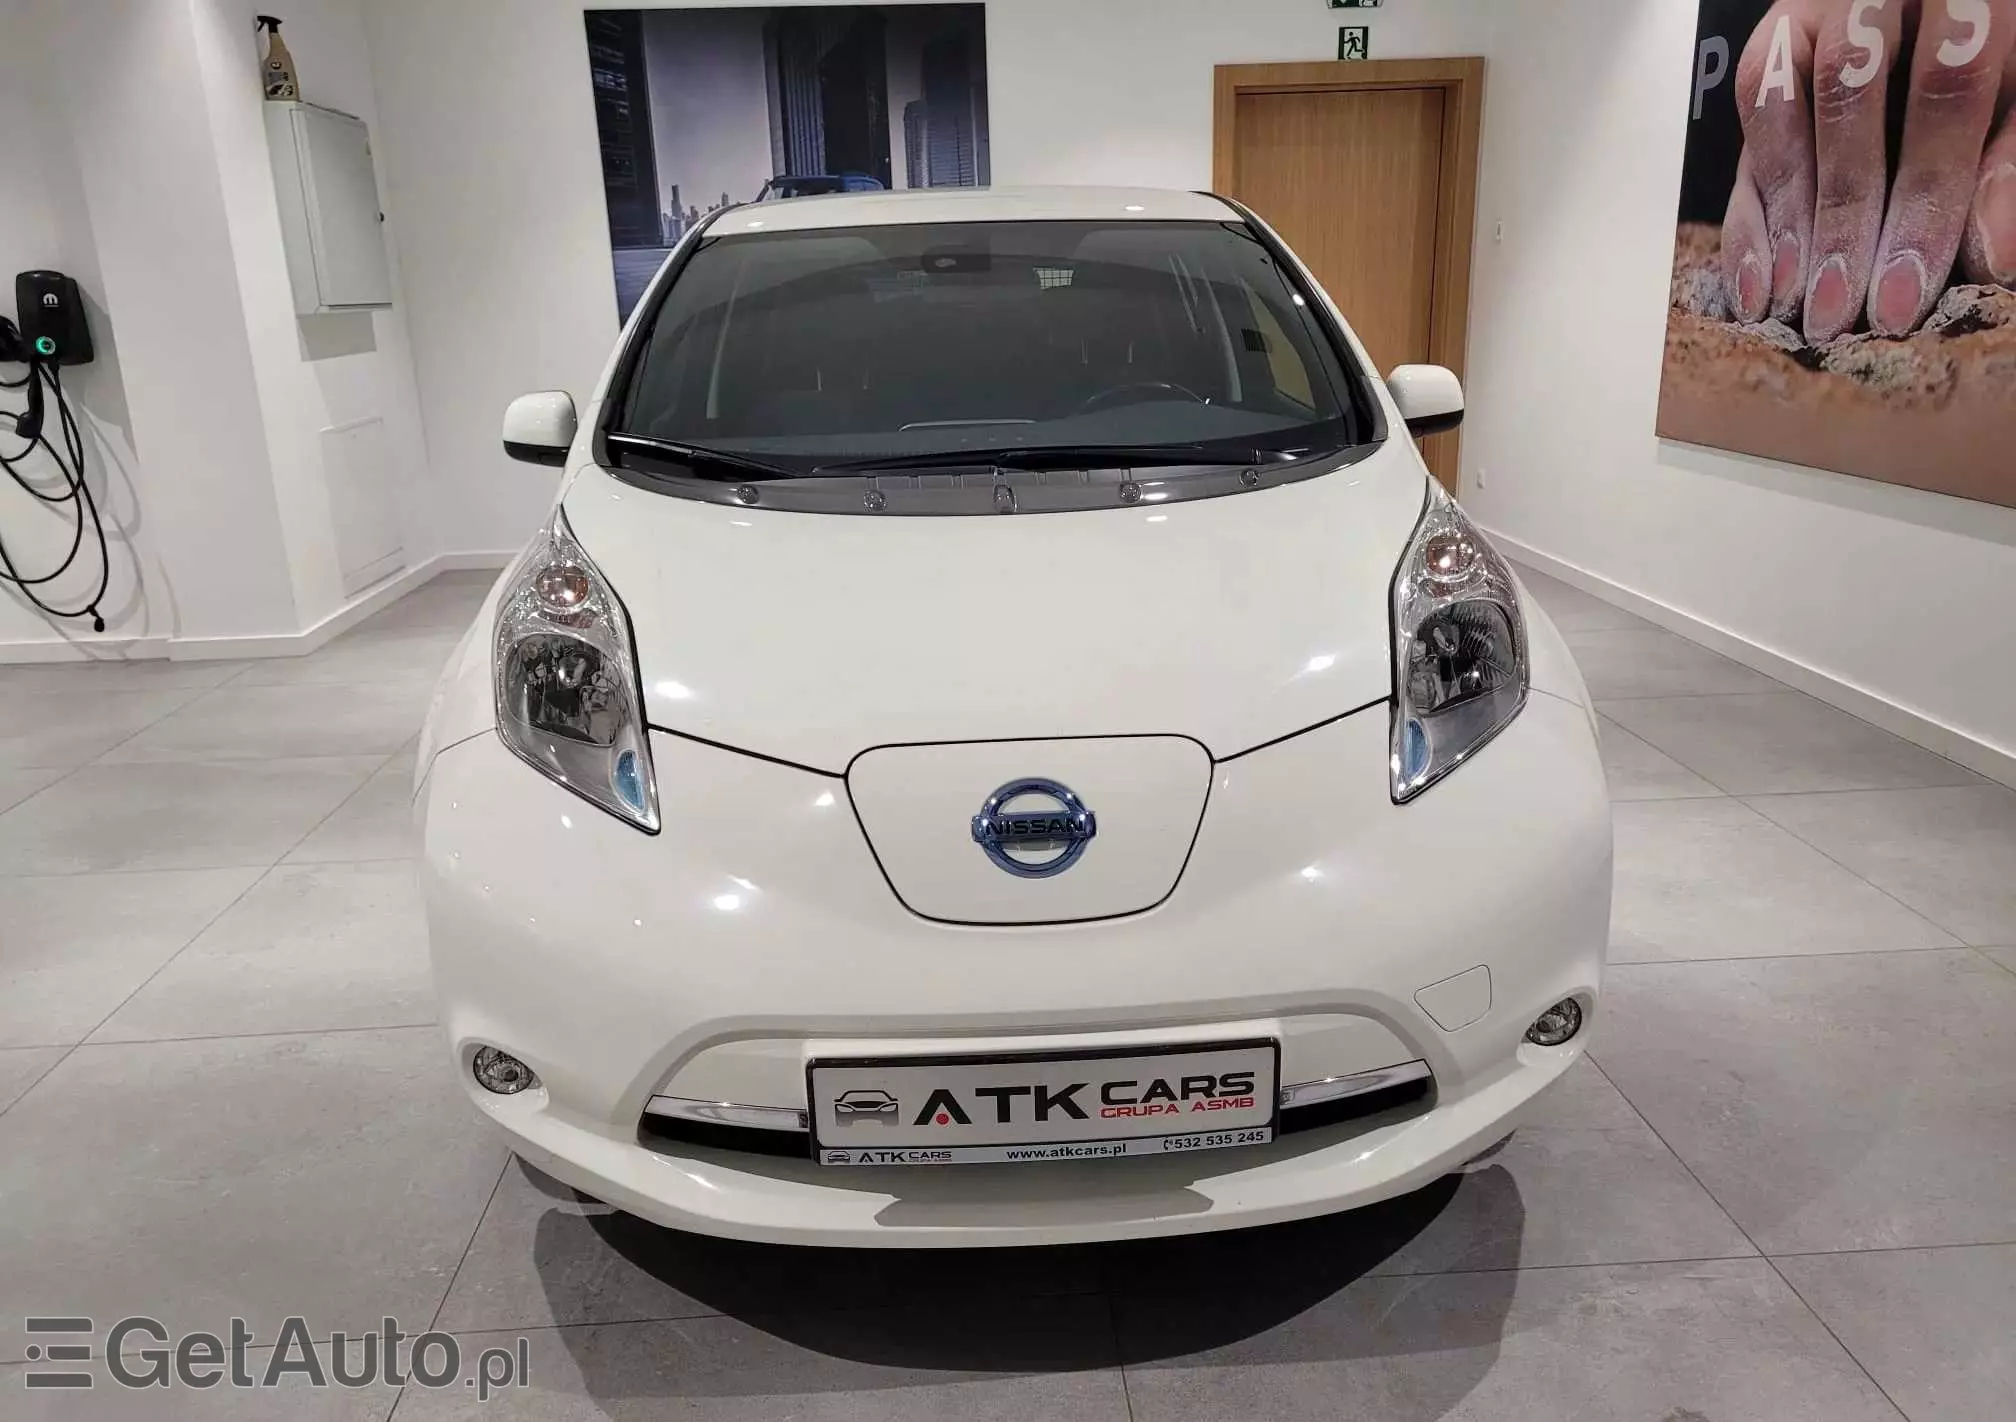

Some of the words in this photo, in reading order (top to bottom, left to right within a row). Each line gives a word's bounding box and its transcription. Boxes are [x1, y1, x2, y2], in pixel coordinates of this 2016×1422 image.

[986, 817, 1084, 835] NISSAN
[912, 1082, 1090, 1126] ATK
[1101, 1072, 1255, 1106] CARS
[1101, 1104, 1180, 1119] GRUPA
[1191, 1097, 1255, 1113] ASMB
[1174, 1138, 1202, 1149] 532
[1206, 1134, 1233, 1147] 535
[1237, 1131, 1265, 1143] 245
[858, 1151, 907, 1164] ATK
[908, 1151, 953, 1160] CARS
[1006, 1143, 1127, 1160] www.atkcars.pl
